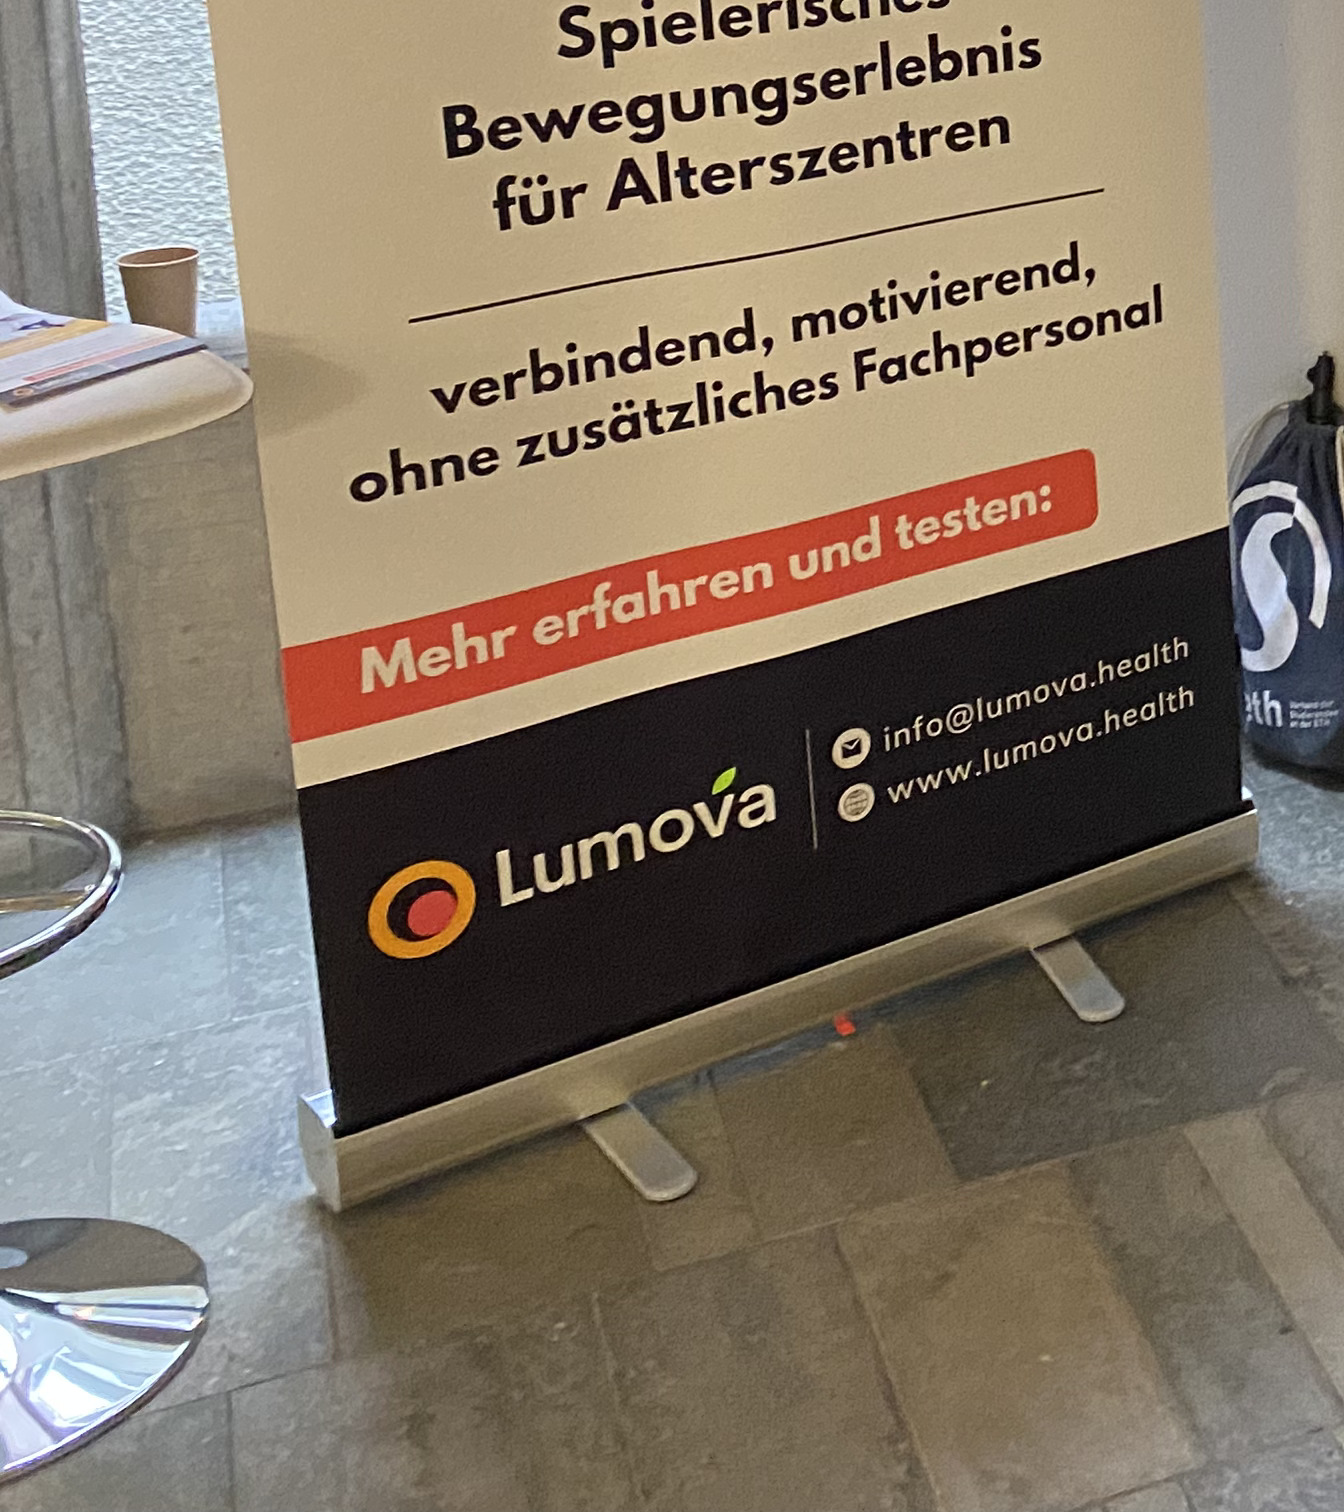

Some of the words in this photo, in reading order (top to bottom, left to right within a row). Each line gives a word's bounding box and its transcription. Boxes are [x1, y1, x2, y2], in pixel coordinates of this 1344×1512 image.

[441, 24, 1043, 159] Bewegungserlebnis
[492, 174, 588, 232] für
[606, 113, 1013, 213] Alterszentren
[348, 447, 501, 504] ohne
[516, 366, 840, 468] zusätzliches
[853, 283, 1166, 393] Fachpersonal
[430, 306, 775, 416] verbindend,
[790, 241, 1098, 343] motivierend,
[360, 616, 518, 695] Mehr
[531, 556, 775, 648] erfahren
[789, 515, 882, 582] und
[895, 479, 1054, 550] testen:
[883, 636, 1190, 752] info@lumova.health
[887, 686, 1195, 803] www.lumova.health
[494, 778, 778, 907] Lumova
